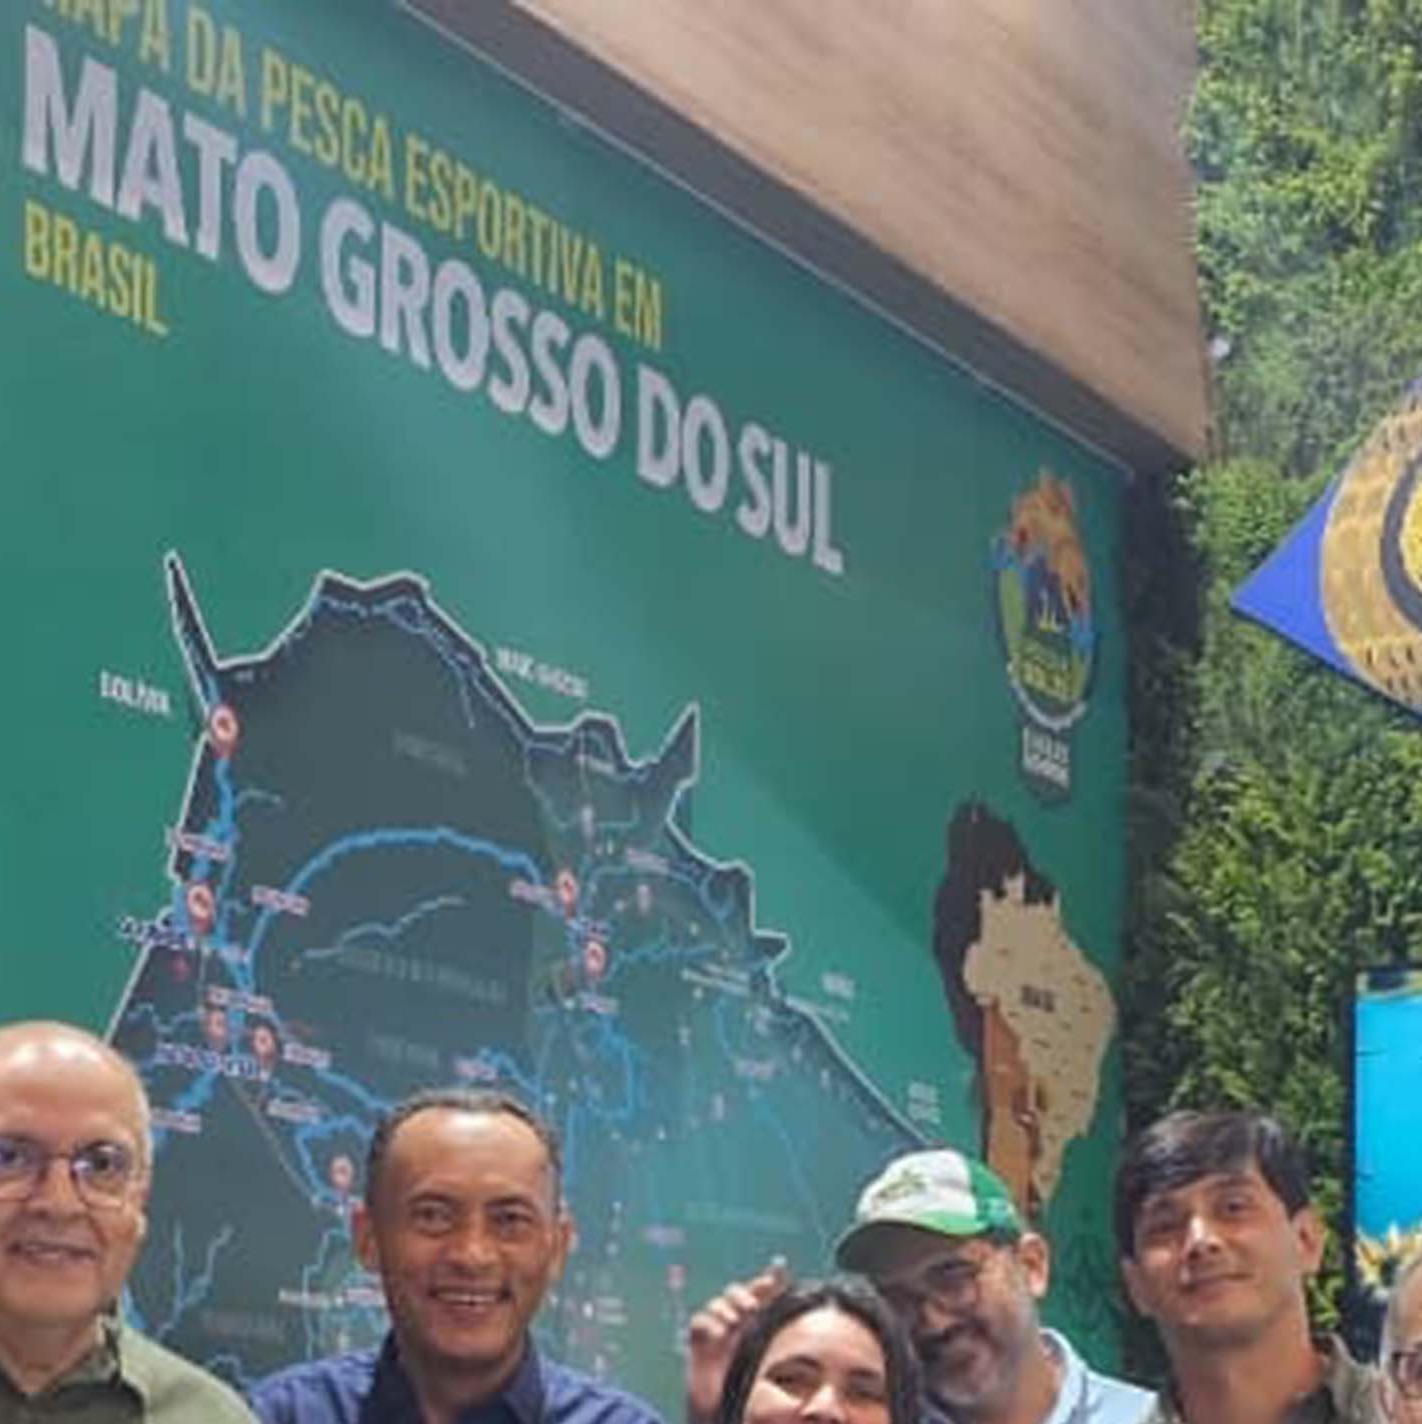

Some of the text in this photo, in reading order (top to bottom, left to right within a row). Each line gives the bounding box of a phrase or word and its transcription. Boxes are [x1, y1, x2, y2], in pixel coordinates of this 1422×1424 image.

[23, 23, 844, 575] MATO GROSSO DO SUL
[24, 199, 169, 337] BRASIL
[186, 4, 249, 119] DA
[261, 46, 393, 200] PESCA
[405, 133, 603, 320] ESPORTIVA
[614, 258, 663, 350] EM
